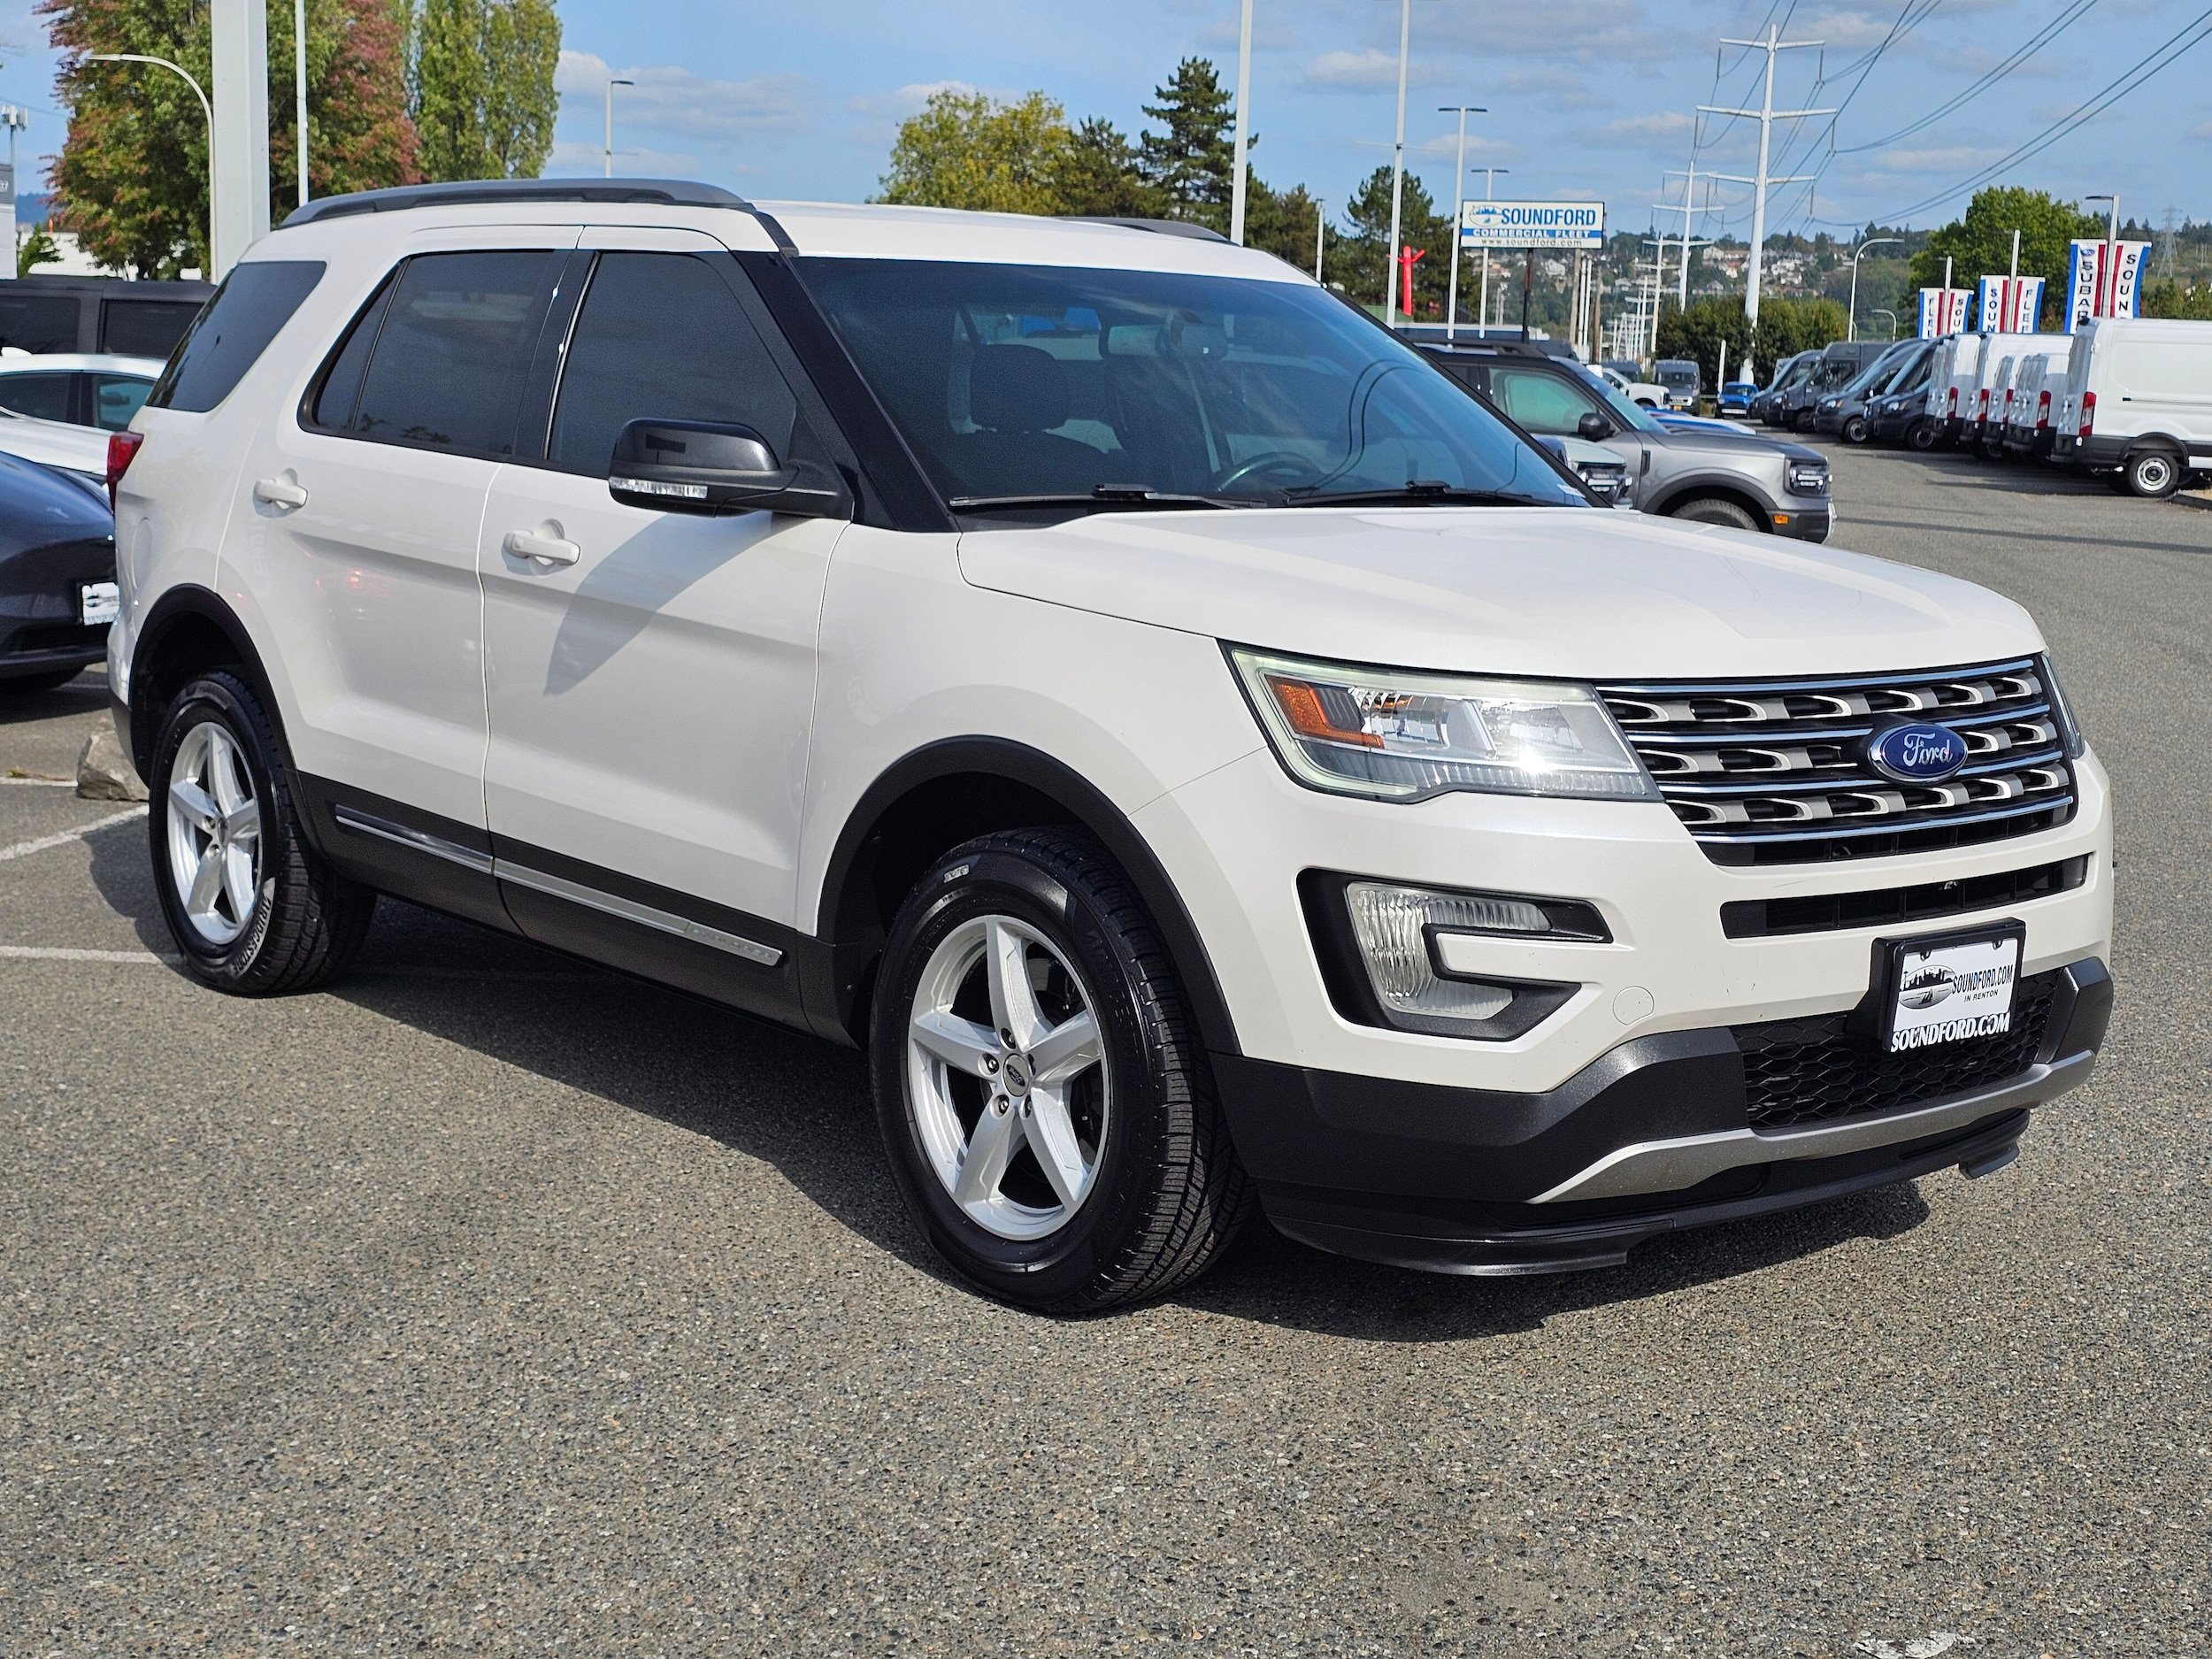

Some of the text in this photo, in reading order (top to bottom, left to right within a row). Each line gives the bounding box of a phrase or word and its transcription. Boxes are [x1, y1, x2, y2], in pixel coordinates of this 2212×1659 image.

[1501, 208, 1596, 226] SOUNDFORD
[1472, 228, 1591, 239] COMMERCIAL FLEET
[1481, 237, 1582, 247] www.soundford.com
[2076, 261, 2093, 330] SUBAR
[2118, 254, 2138, 319] SOUN
[1902, 733, 1954, 767] Ford
[1952, 964, 2014, 995] SOUNDFORD.COM
[1964, 988, 1999, 1002] IN RENTON
[1891, 1011, 2011, 1053] SOUNDFORD.COM
